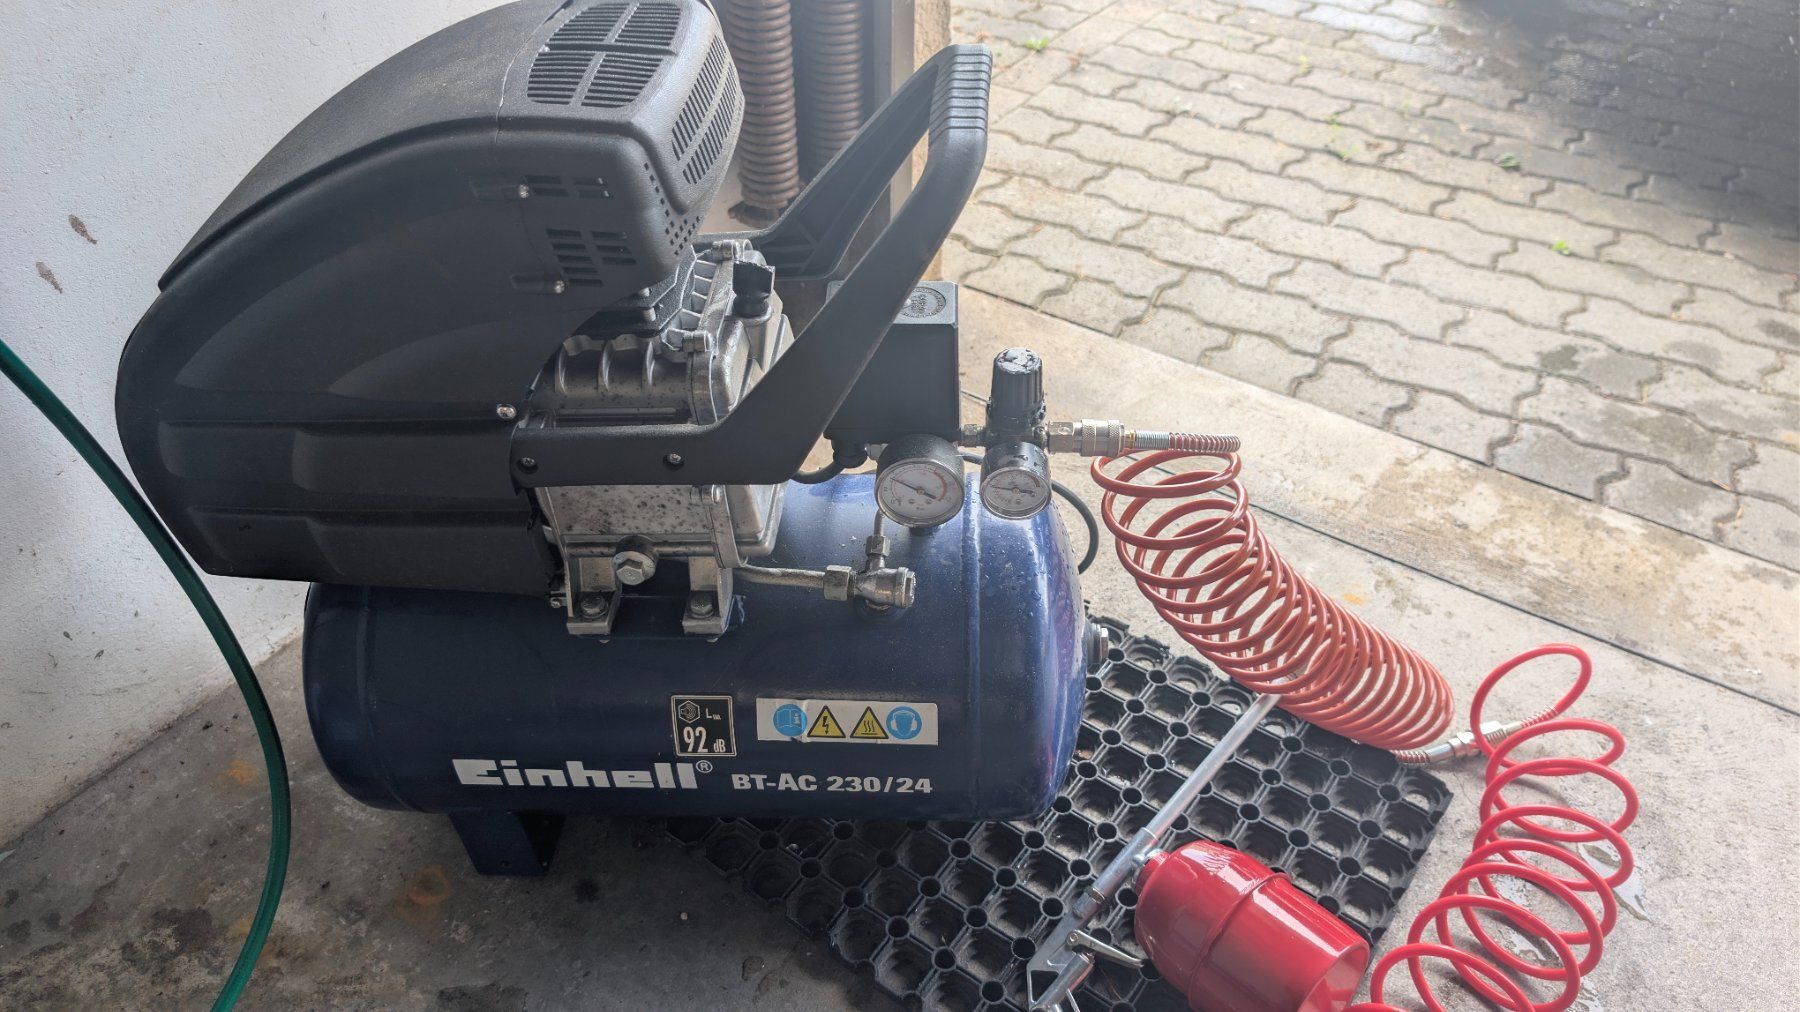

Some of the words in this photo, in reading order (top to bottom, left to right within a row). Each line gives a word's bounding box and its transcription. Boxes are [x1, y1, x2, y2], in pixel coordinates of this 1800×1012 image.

[683, 726, 708, 753] 92
[713, 738, 726, 753] dB
[731, 773, 818, 791] BT-AC
[826, 776, 933, 794] 230/24
